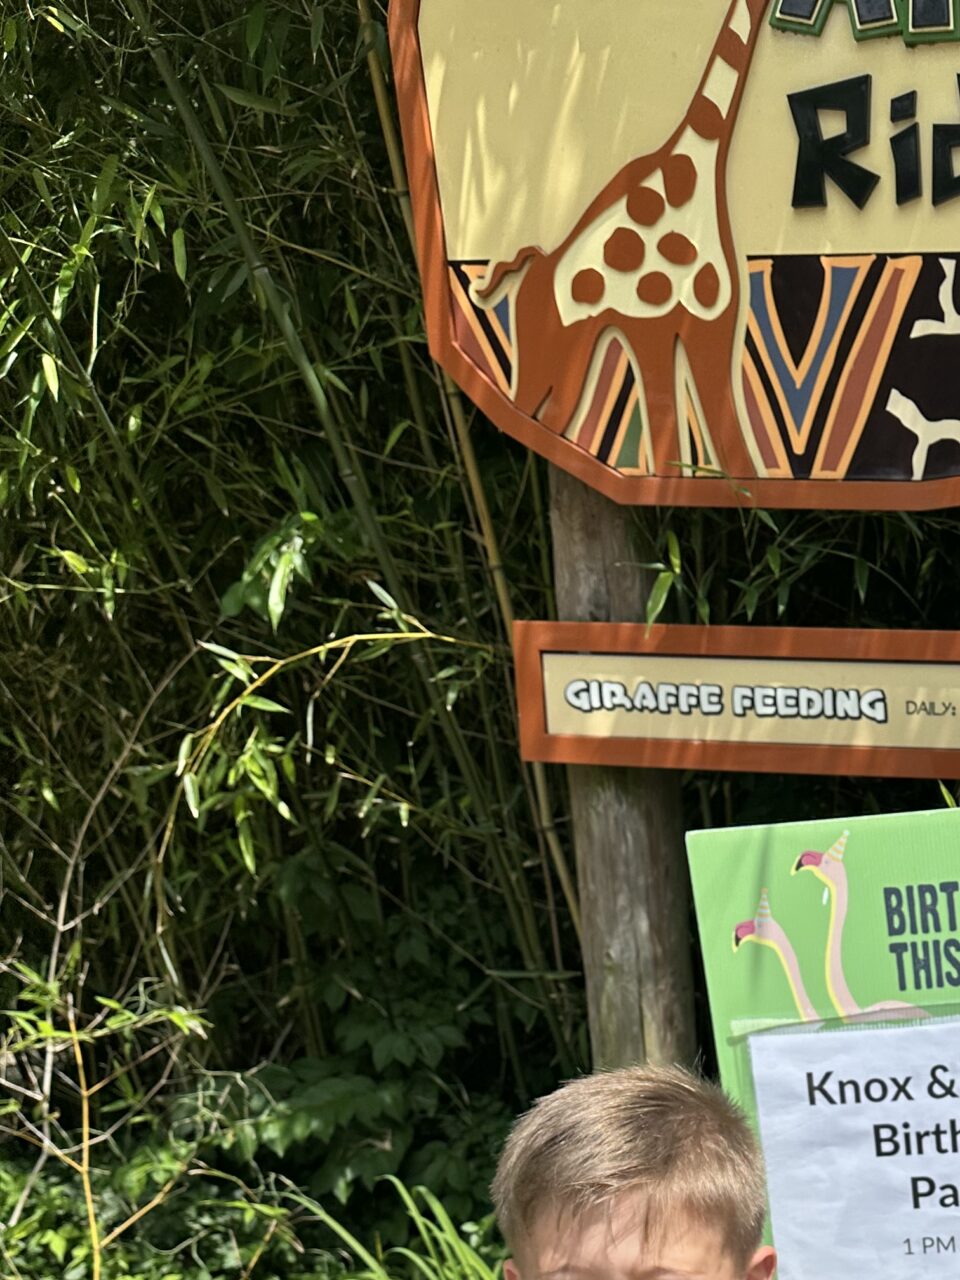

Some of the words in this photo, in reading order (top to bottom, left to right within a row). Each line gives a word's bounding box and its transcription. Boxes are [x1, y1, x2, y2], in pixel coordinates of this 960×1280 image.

[564, 679, 724, 713] GIRAFFE
[732, 685, 888, 723] FEEDING
[905, 700, 957, 716] DAILY:
[805, 1070, 915, 1106] Knox
[927, 1064, 959, 1100] &
[903, 1237, 915, 1255] 1
[922, 1235, 957, 1254] PM
